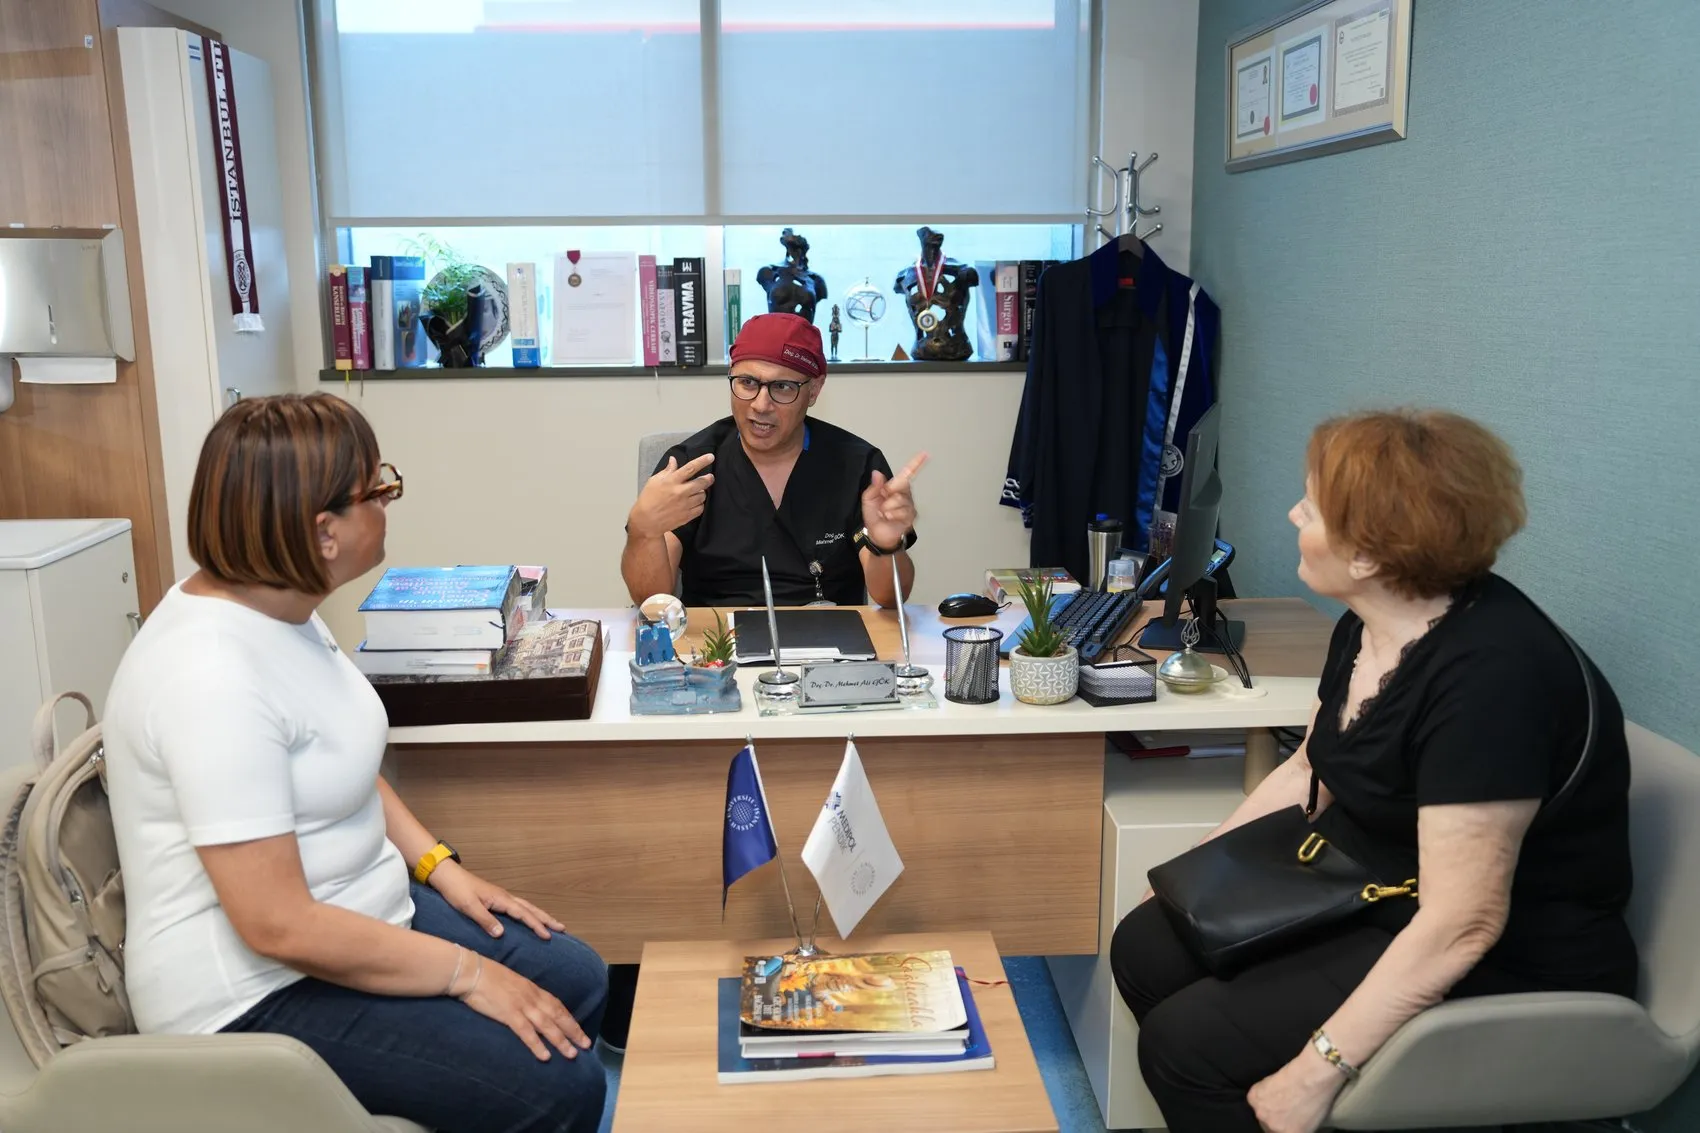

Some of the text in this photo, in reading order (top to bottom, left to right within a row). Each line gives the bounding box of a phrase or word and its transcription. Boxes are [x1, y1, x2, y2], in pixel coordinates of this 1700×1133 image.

[681, 281, 695, 336] TRAVMA
[1000, 294, 1013, 331] Surgery
[835, 679, 860, 689] Mehmet
